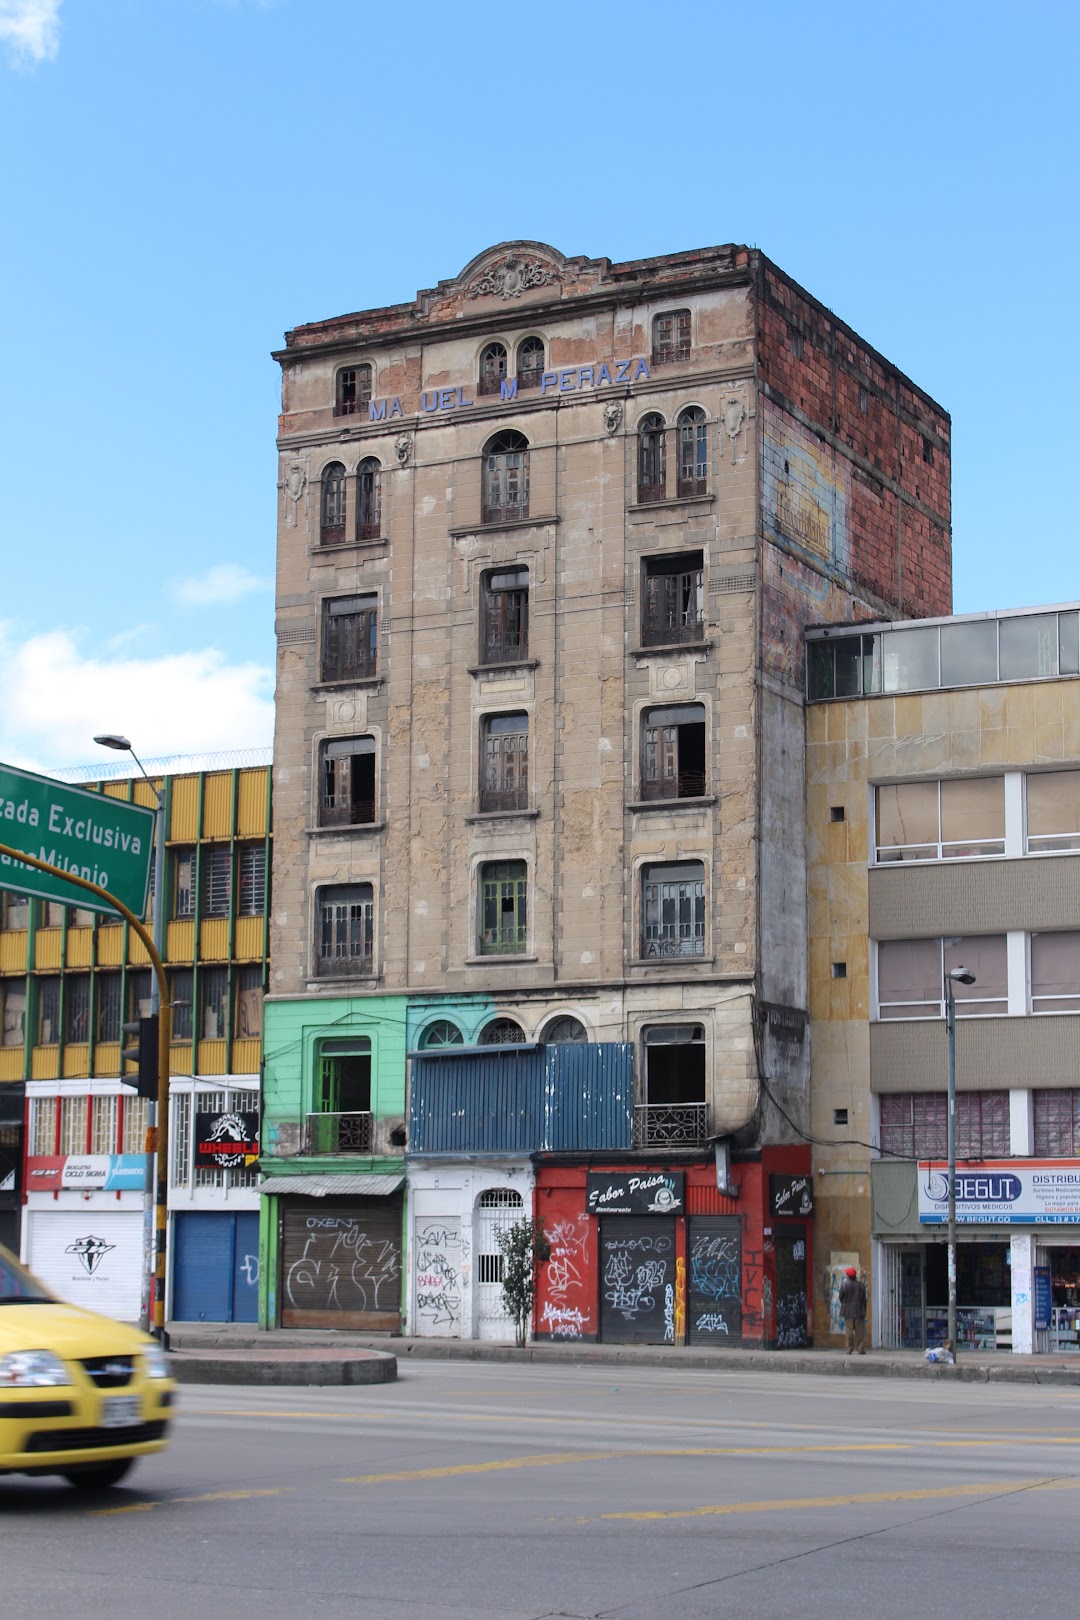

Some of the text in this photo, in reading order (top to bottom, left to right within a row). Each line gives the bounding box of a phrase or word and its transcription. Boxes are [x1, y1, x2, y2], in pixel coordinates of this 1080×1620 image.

[500, 377, 518, 400] M
[541, 358, 651, 394] PERAZA
[48, 804, 141, 855] Exclusiva
[589, 1175, 666, 1206] Sabor Paisa
